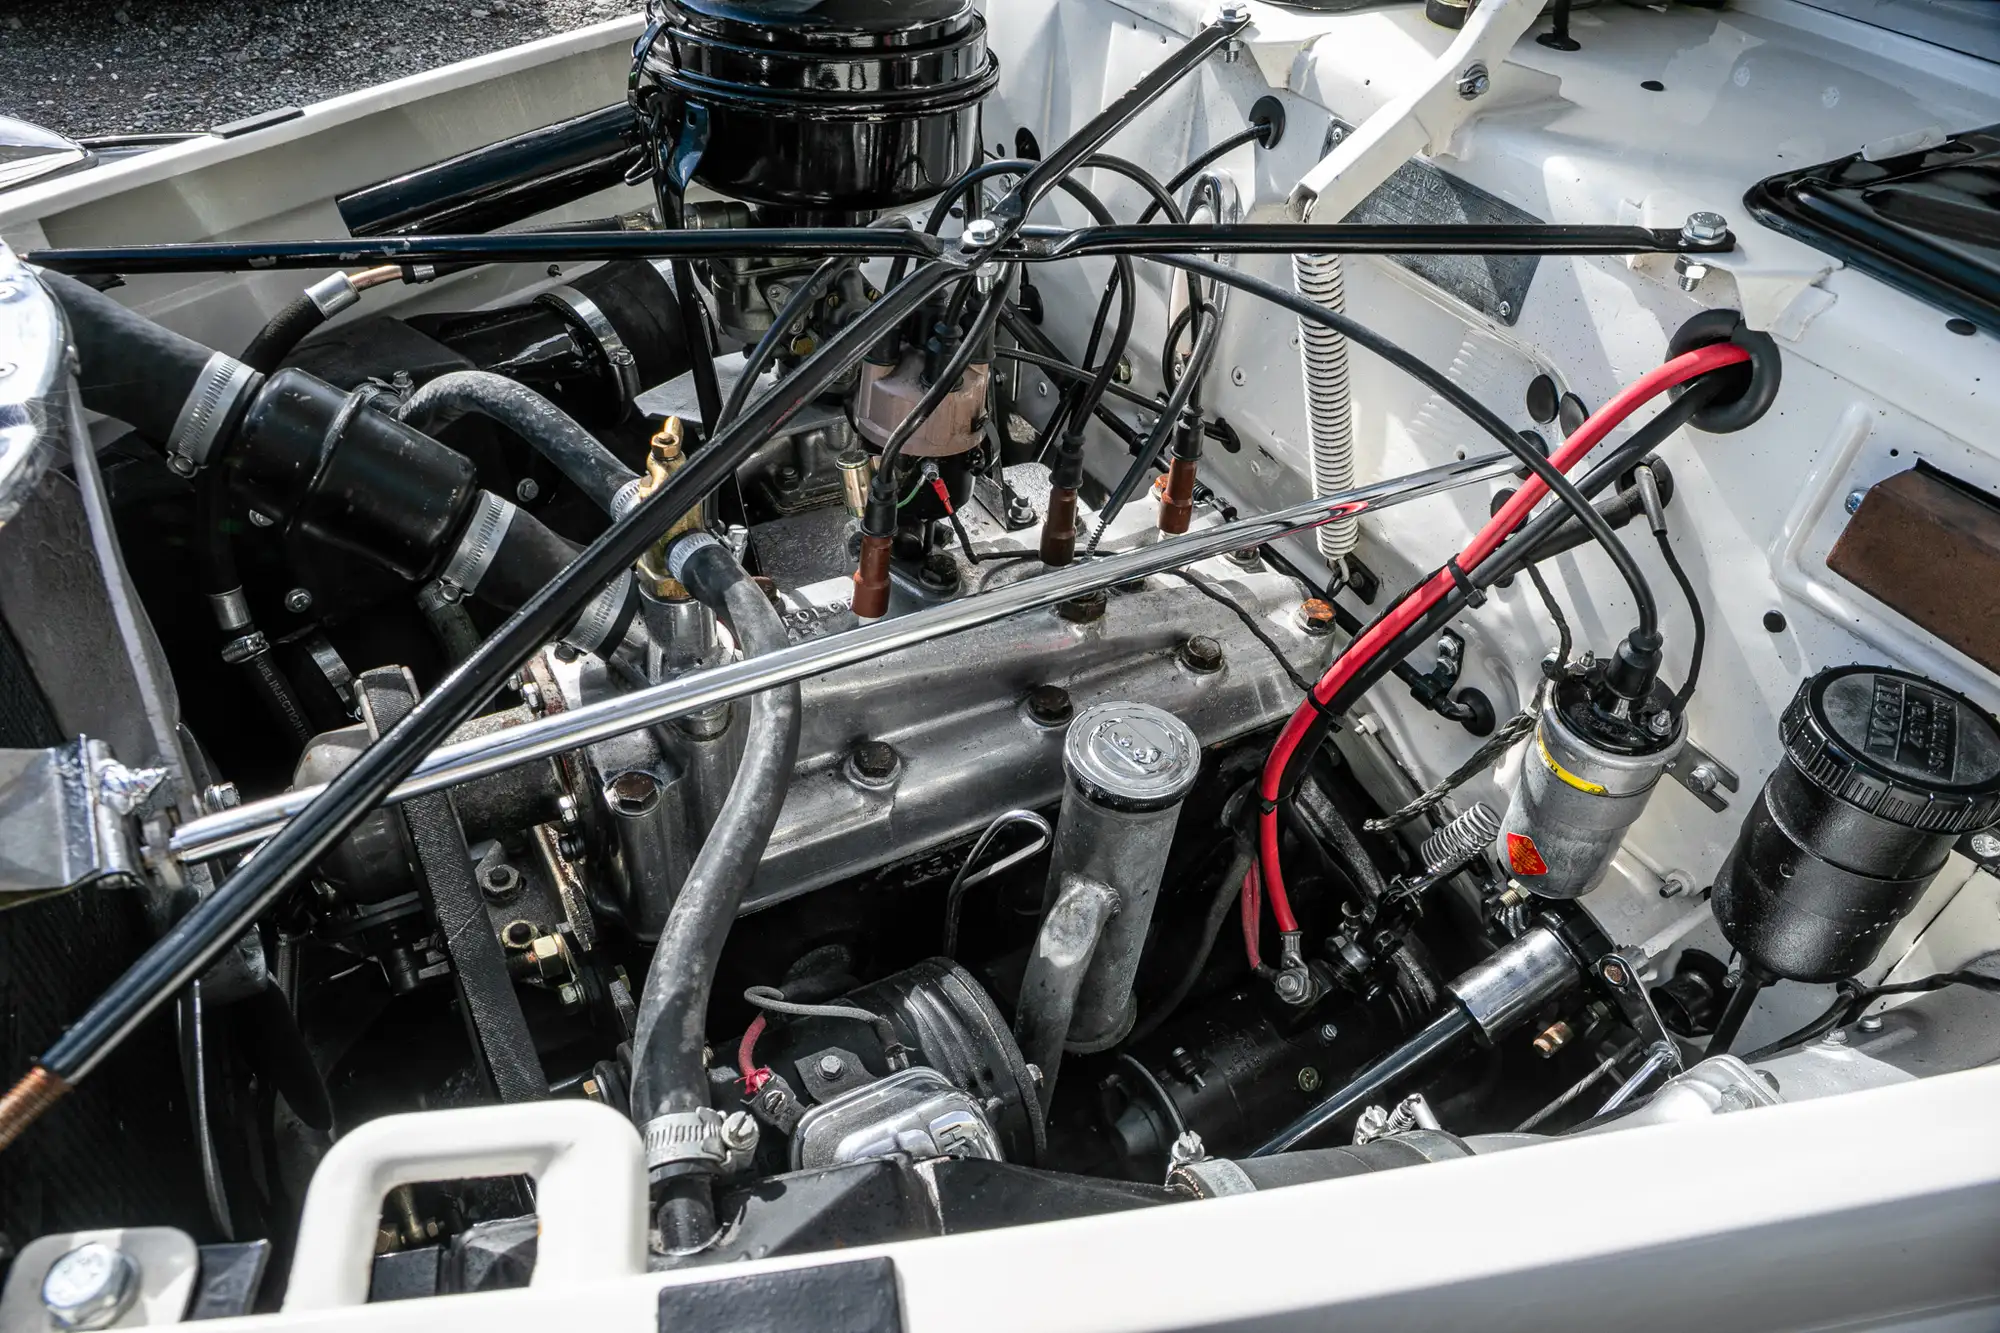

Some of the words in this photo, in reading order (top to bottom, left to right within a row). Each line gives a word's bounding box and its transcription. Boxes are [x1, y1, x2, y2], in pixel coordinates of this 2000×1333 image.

[254, 655, 273, 682] FUEL
[268, 679, 304, 730] INJECTION
[1869, 684, 1902, 747] VOGEL
